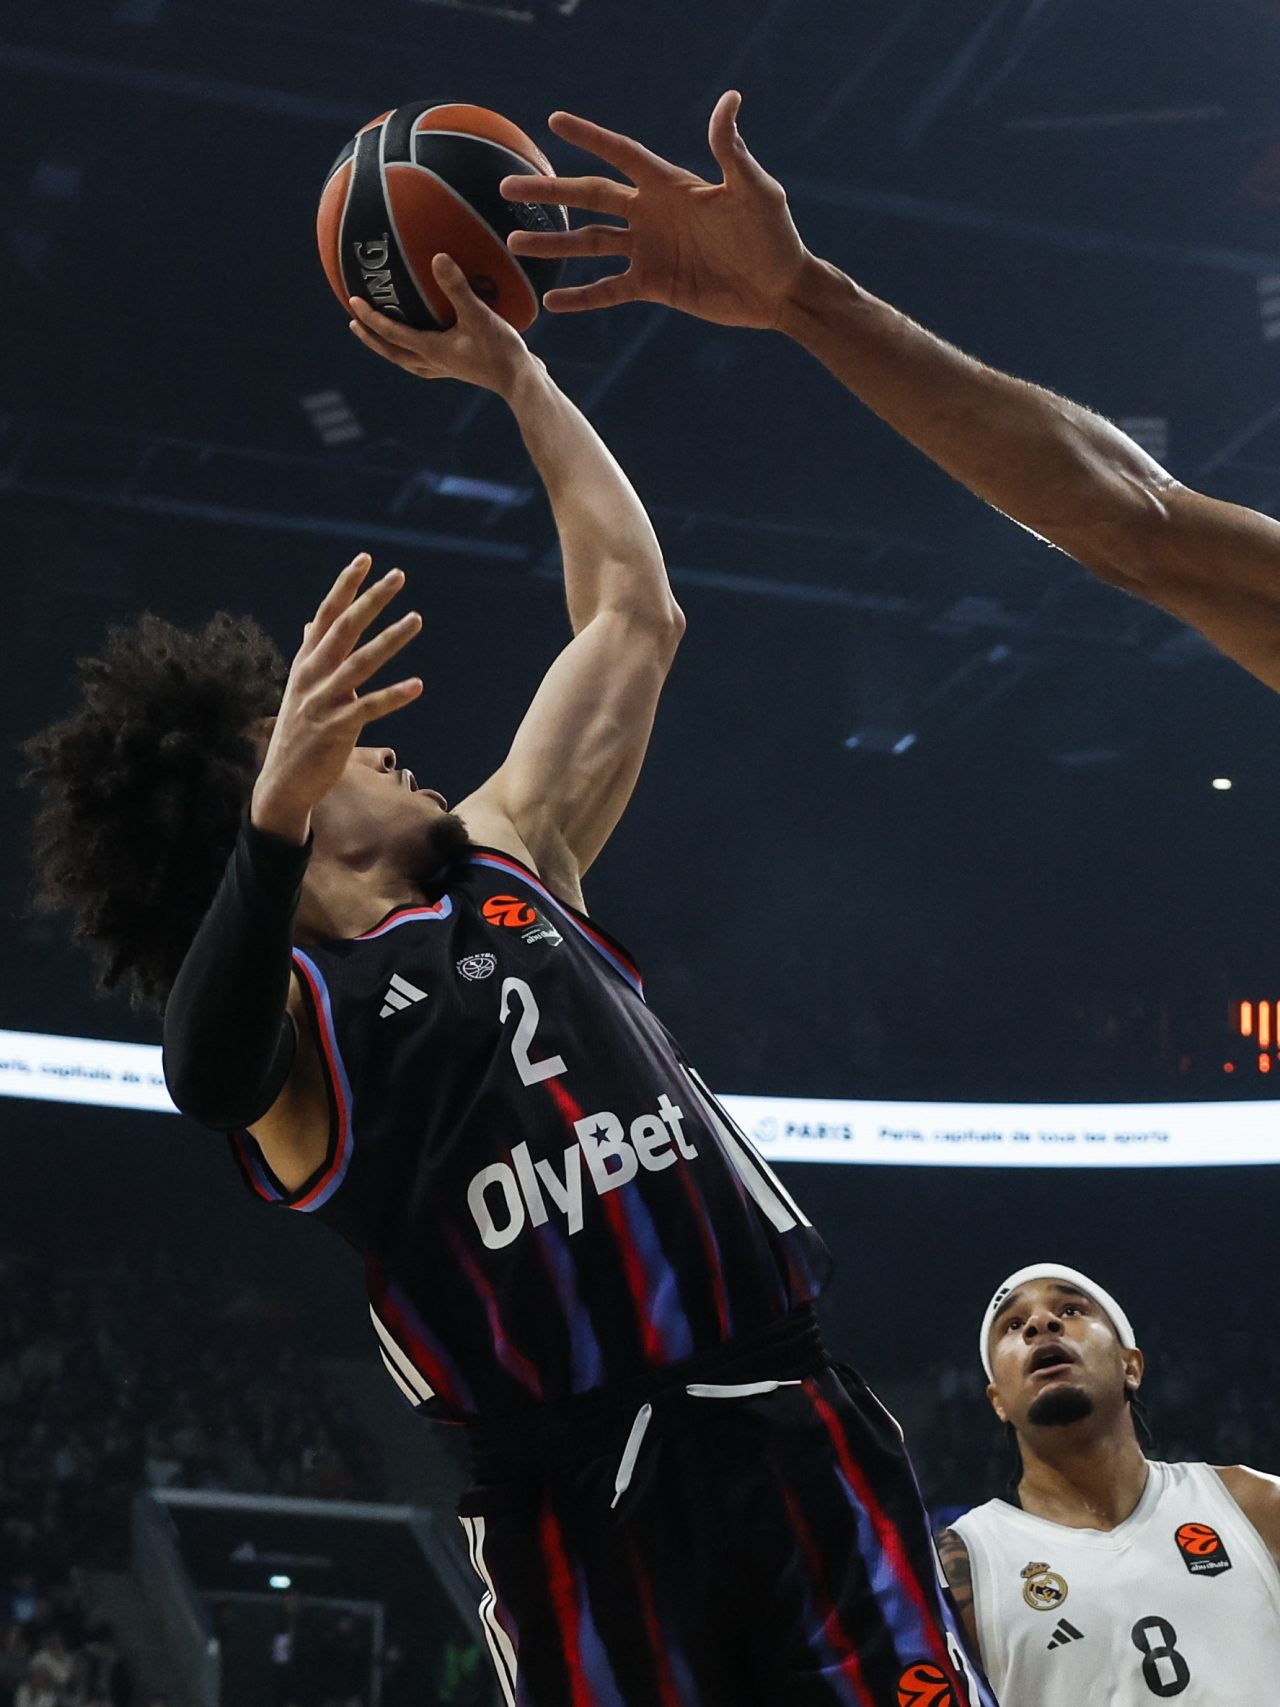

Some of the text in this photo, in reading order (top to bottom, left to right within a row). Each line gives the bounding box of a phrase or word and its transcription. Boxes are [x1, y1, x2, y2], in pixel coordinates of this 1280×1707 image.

[500, 977, 568, 1086] 2
[467, 1093, 699, 1250] OlyBet
[1131, 1615, 1190, 1697] 8
